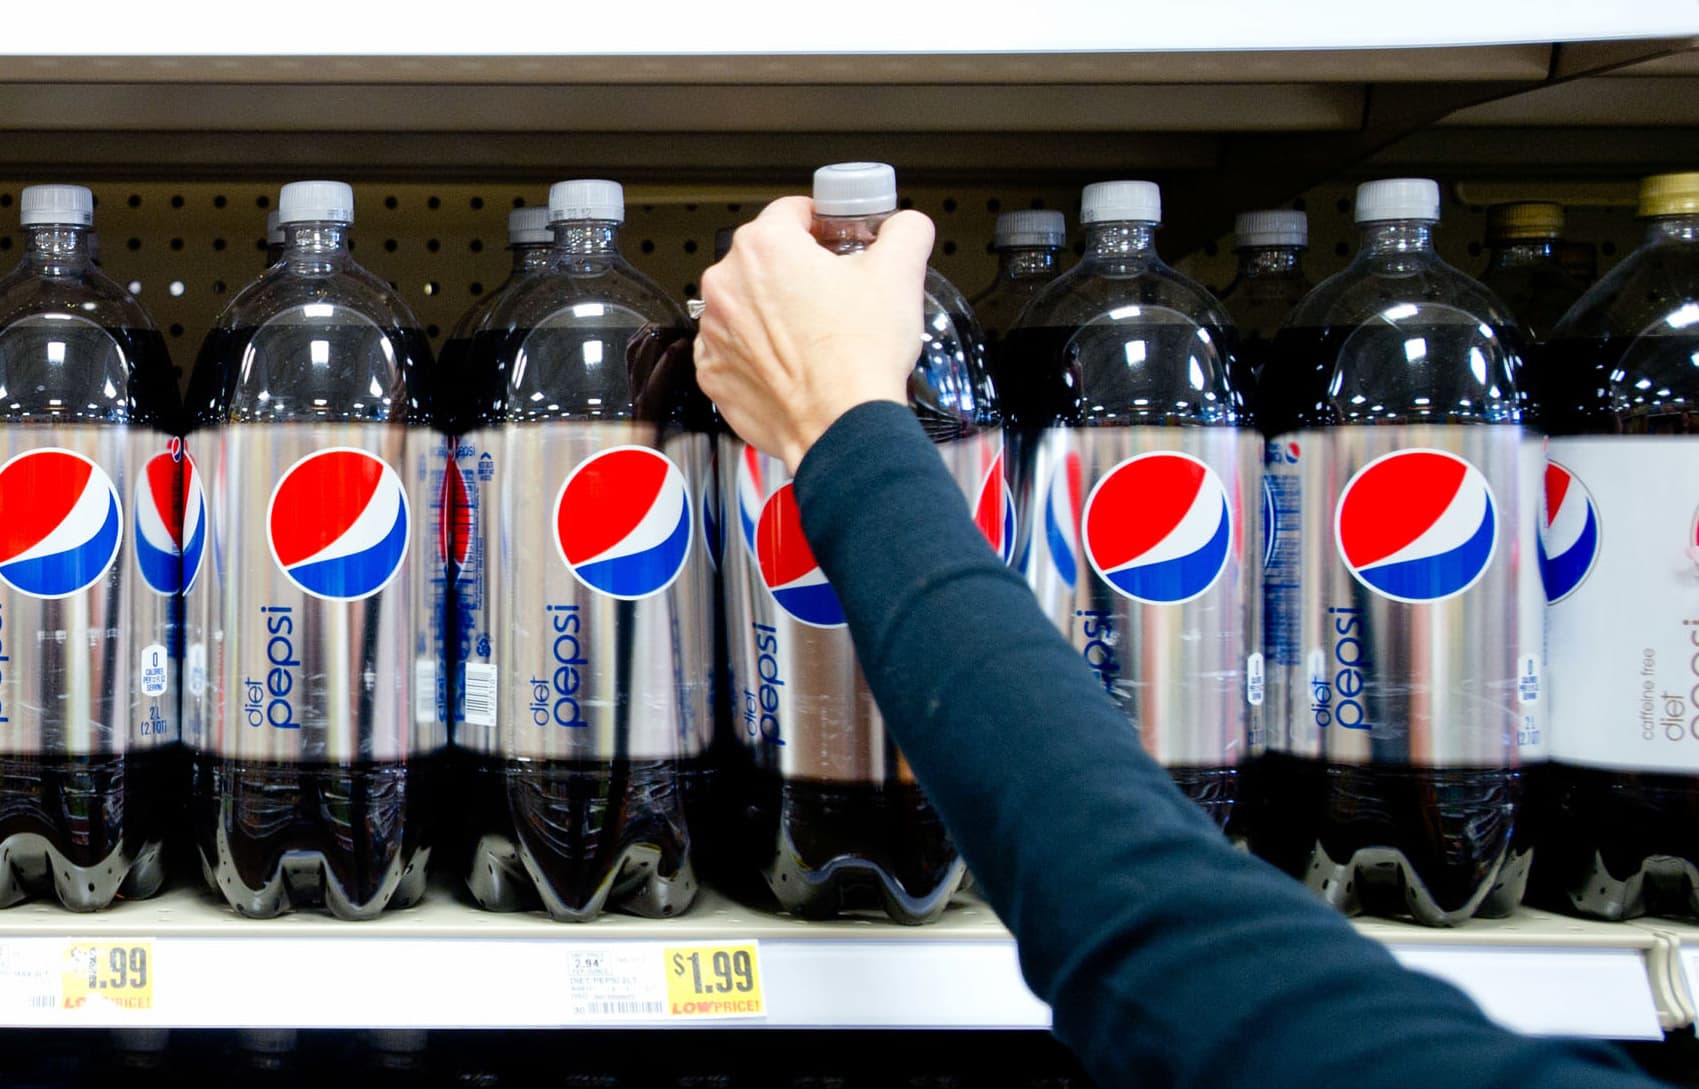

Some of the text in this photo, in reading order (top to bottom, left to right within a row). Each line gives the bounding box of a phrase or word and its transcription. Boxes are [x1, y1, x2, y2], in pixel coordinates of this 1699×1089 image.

[261, 606, 300, 729] pepsi
[546, 605, 588, 728] pepsi
[752, 621, 785, 746] pepsi
[1076, 608, 1120, 693] psi
[1328, 607, 1373, 731] pepsi
[245, 676, 263, 728] diet
[530, 675, 550, 727] diet
[744, 687, 757, 737] diet
[1311, 675, 1332, 728] diet
[1640, 647, 1655, 741] caffeine free
[1659, 690, 1685, 742] diet
[673, 950, 753, 994] $1.99
